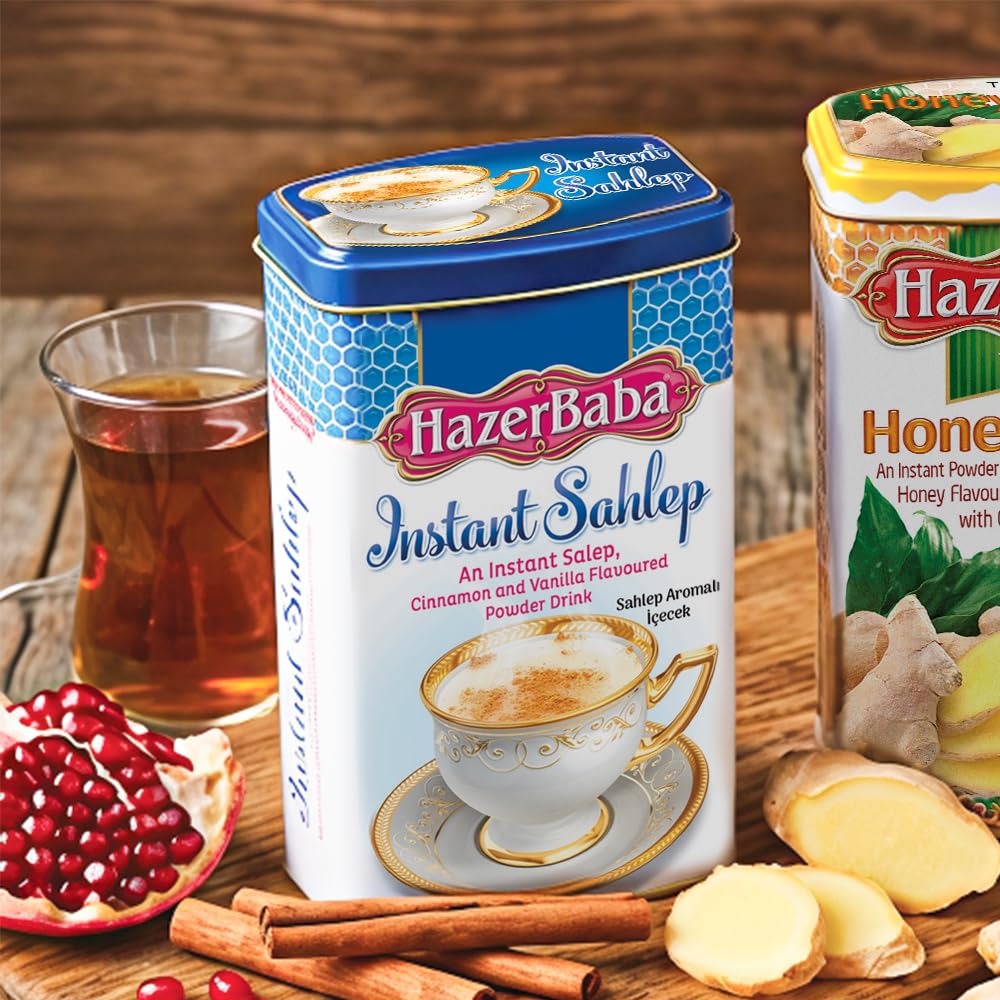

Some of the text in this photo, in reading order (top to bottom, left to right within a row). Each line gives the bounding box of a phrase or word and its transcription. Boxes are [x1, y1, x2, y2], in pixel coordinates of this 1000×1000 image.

[540, 142, 671, 176] Instant
[553, 165, 694, 200] Sahlep
[410, 378, 670, 456] HazerBaba
[877, 461, 1000, 478] An Instant Powder
[366, 449, 711, 568] Instant Sahlep
[897, 486, 946, 507] Honey
[959, 510, 993, 528] with
[459, 542, 621, 583] An Instant Salep,
[410, 554, 668, 612] Cinnamon and Vanilla Flavoured
[616, 580, 720, 611] Sahlep Aromalı
[485, 589, 592, 620] Powder Drink
[647, 604, 691, 626] İçecek
